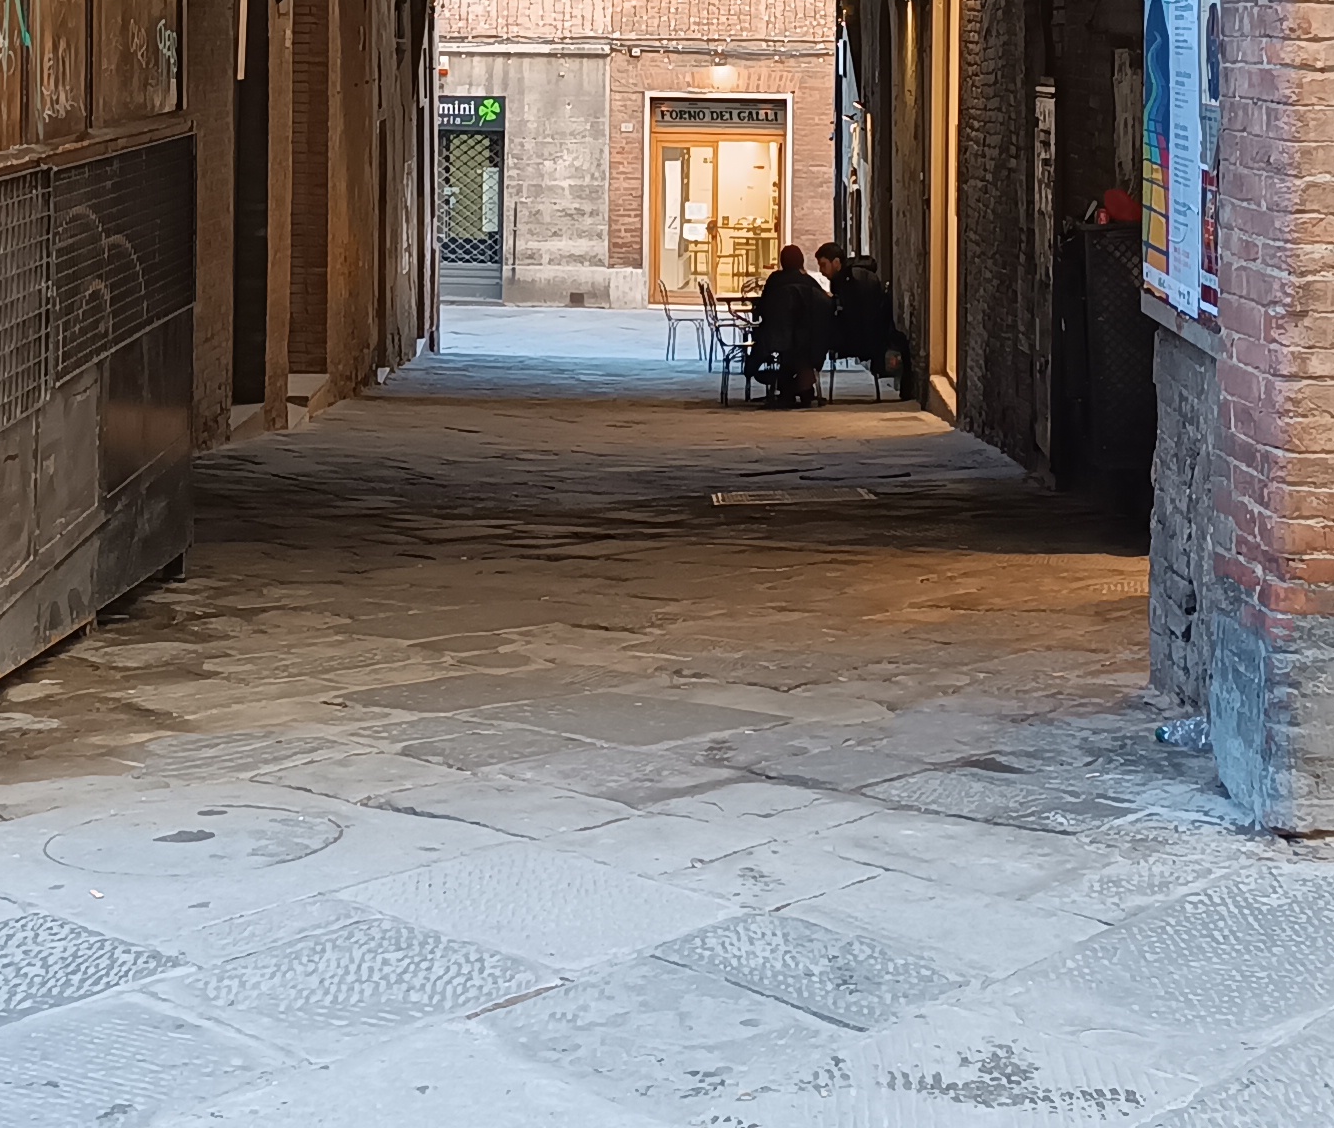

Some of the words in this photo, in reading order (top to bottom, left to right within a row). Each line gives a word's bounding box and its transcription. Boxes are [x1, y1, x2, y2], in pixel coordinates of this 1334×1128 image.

[660, 109, 706, 121] FORNO
[710, 110, 734, 121] DEI
[737, 110, 779, 122] GALLI
